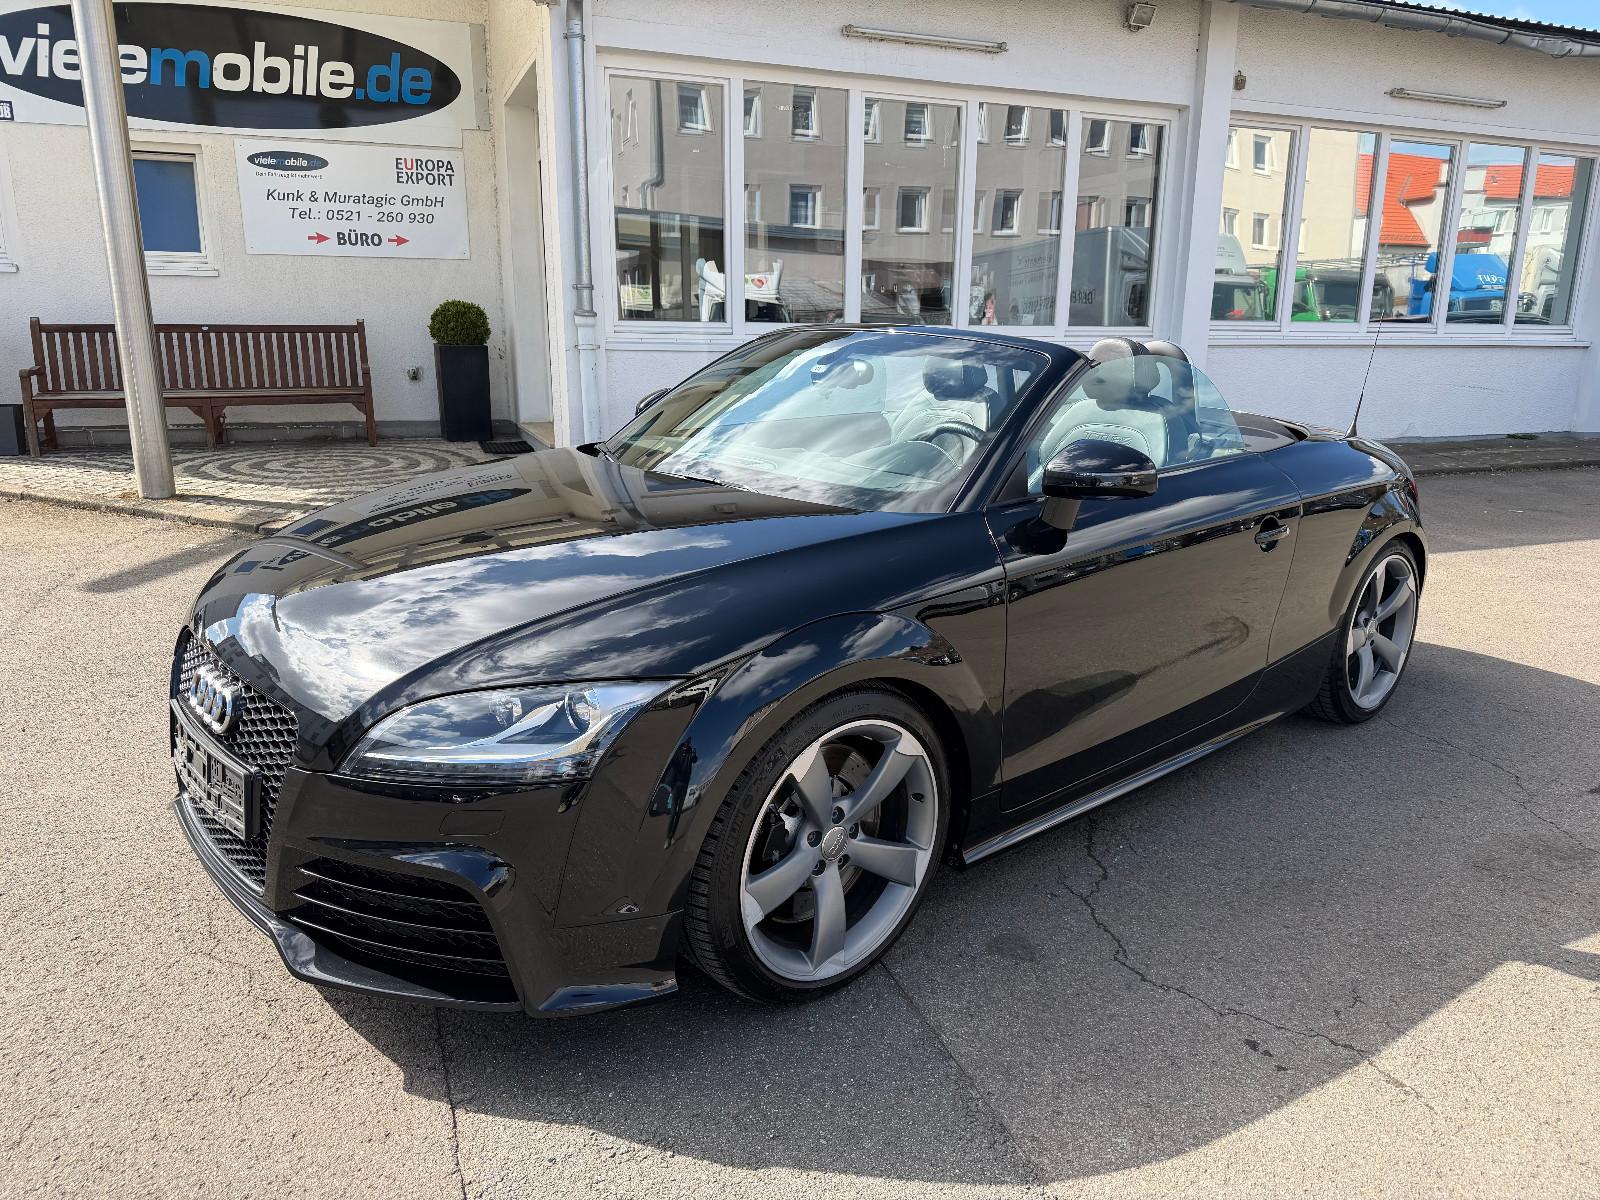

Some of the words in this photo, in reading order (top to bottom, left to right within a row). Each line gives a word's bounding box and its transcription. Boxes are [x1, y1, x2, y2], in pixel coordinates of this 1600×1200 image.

[0, 22, 432, 105] vieemobile.de
[395, 157, 455, 173] EUROPA
[396, 171, 455, 186] EXPORT
[266, 188, 304, 202] Kunk
[308, 190, 319, 203] &
[323, 191, 397, 208] Muratagic
[400, 194, 445, 208] GmbH
[288, 207, 321, 220] Tel.:
[326, 209, 361, 222] 0521
[376, 211, 404, 223] 260
[408, 212, 435, 224] 930
[336, 228, 383, 247] BÜRO
